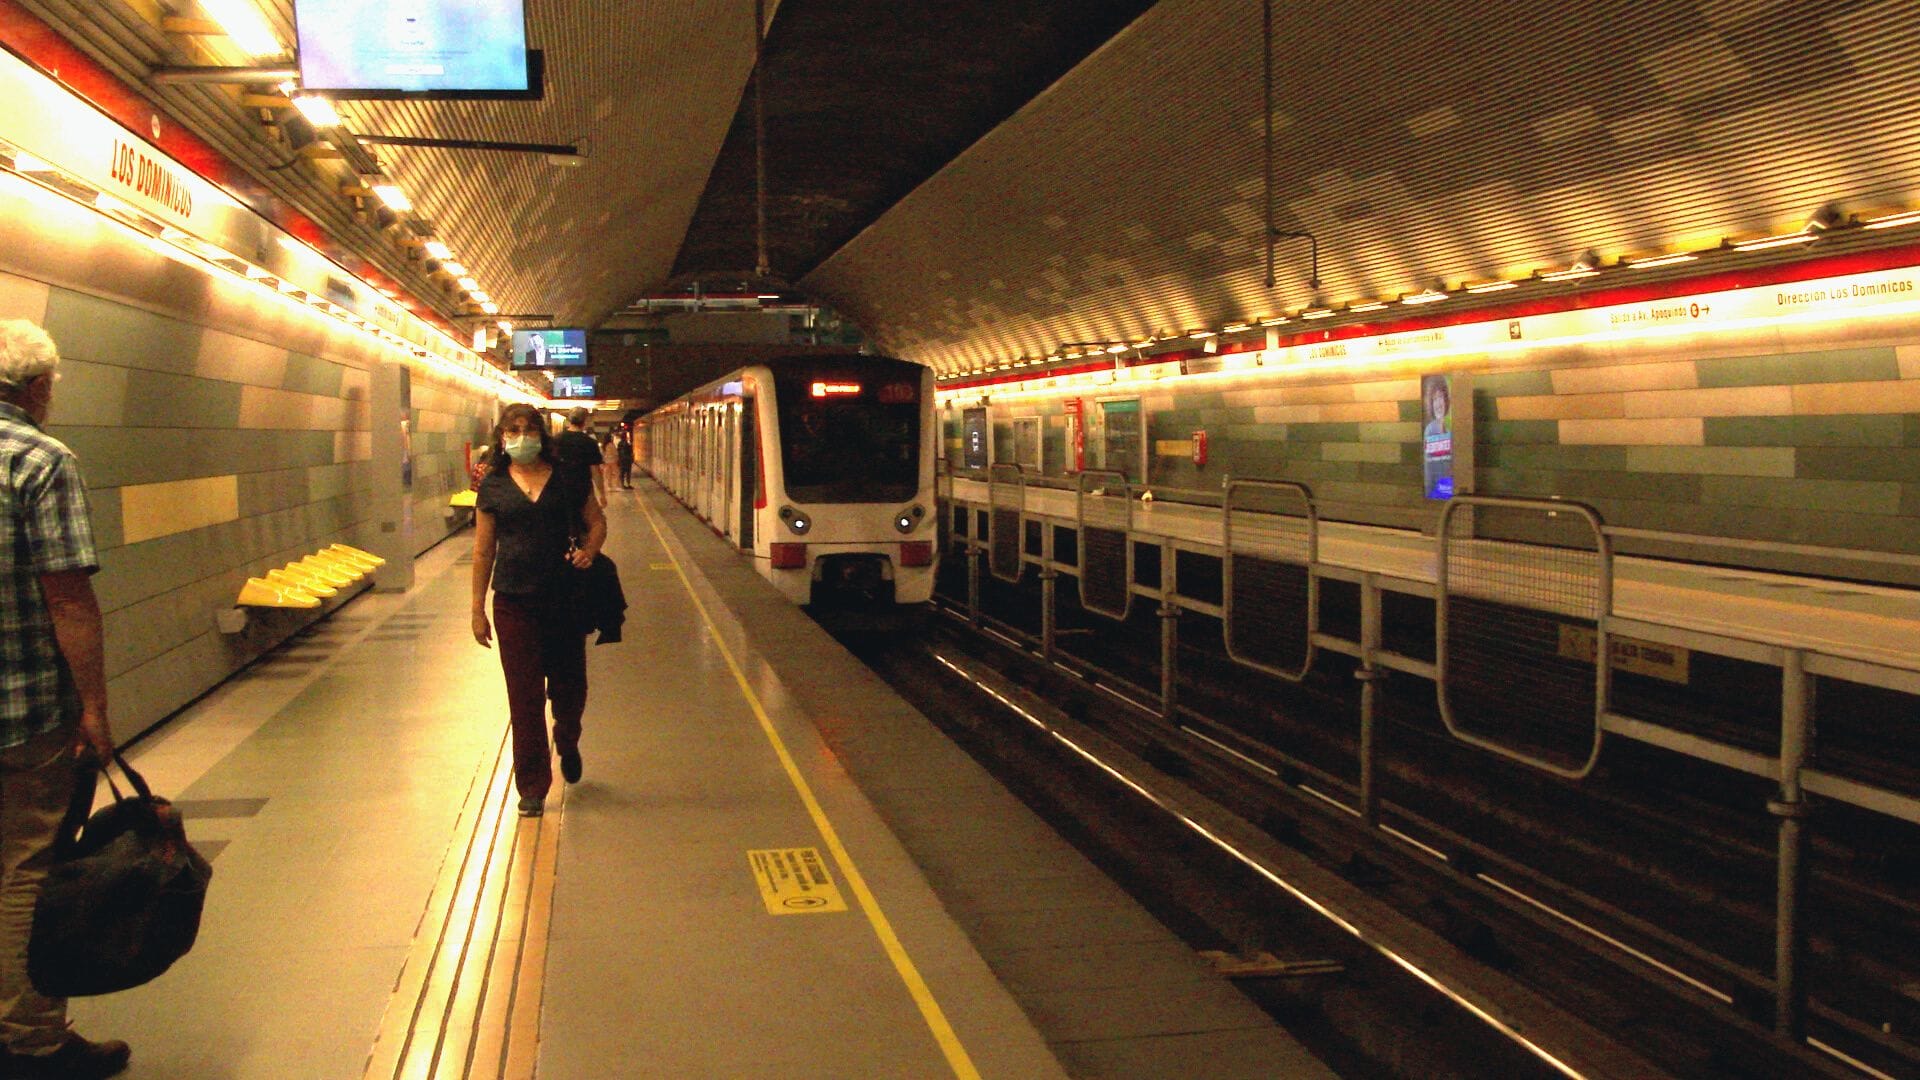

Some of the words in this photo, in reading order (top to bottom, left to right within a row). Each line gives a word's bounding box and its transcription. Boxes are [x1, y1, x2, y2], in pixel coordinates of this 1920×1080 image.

[111, 138, 135, 187] LOS
[136, 154, 192, 218] DOMINICOS
[1830, 287, 1848, 300] Los
[1852, 280, 1913, 297] Dominicos
